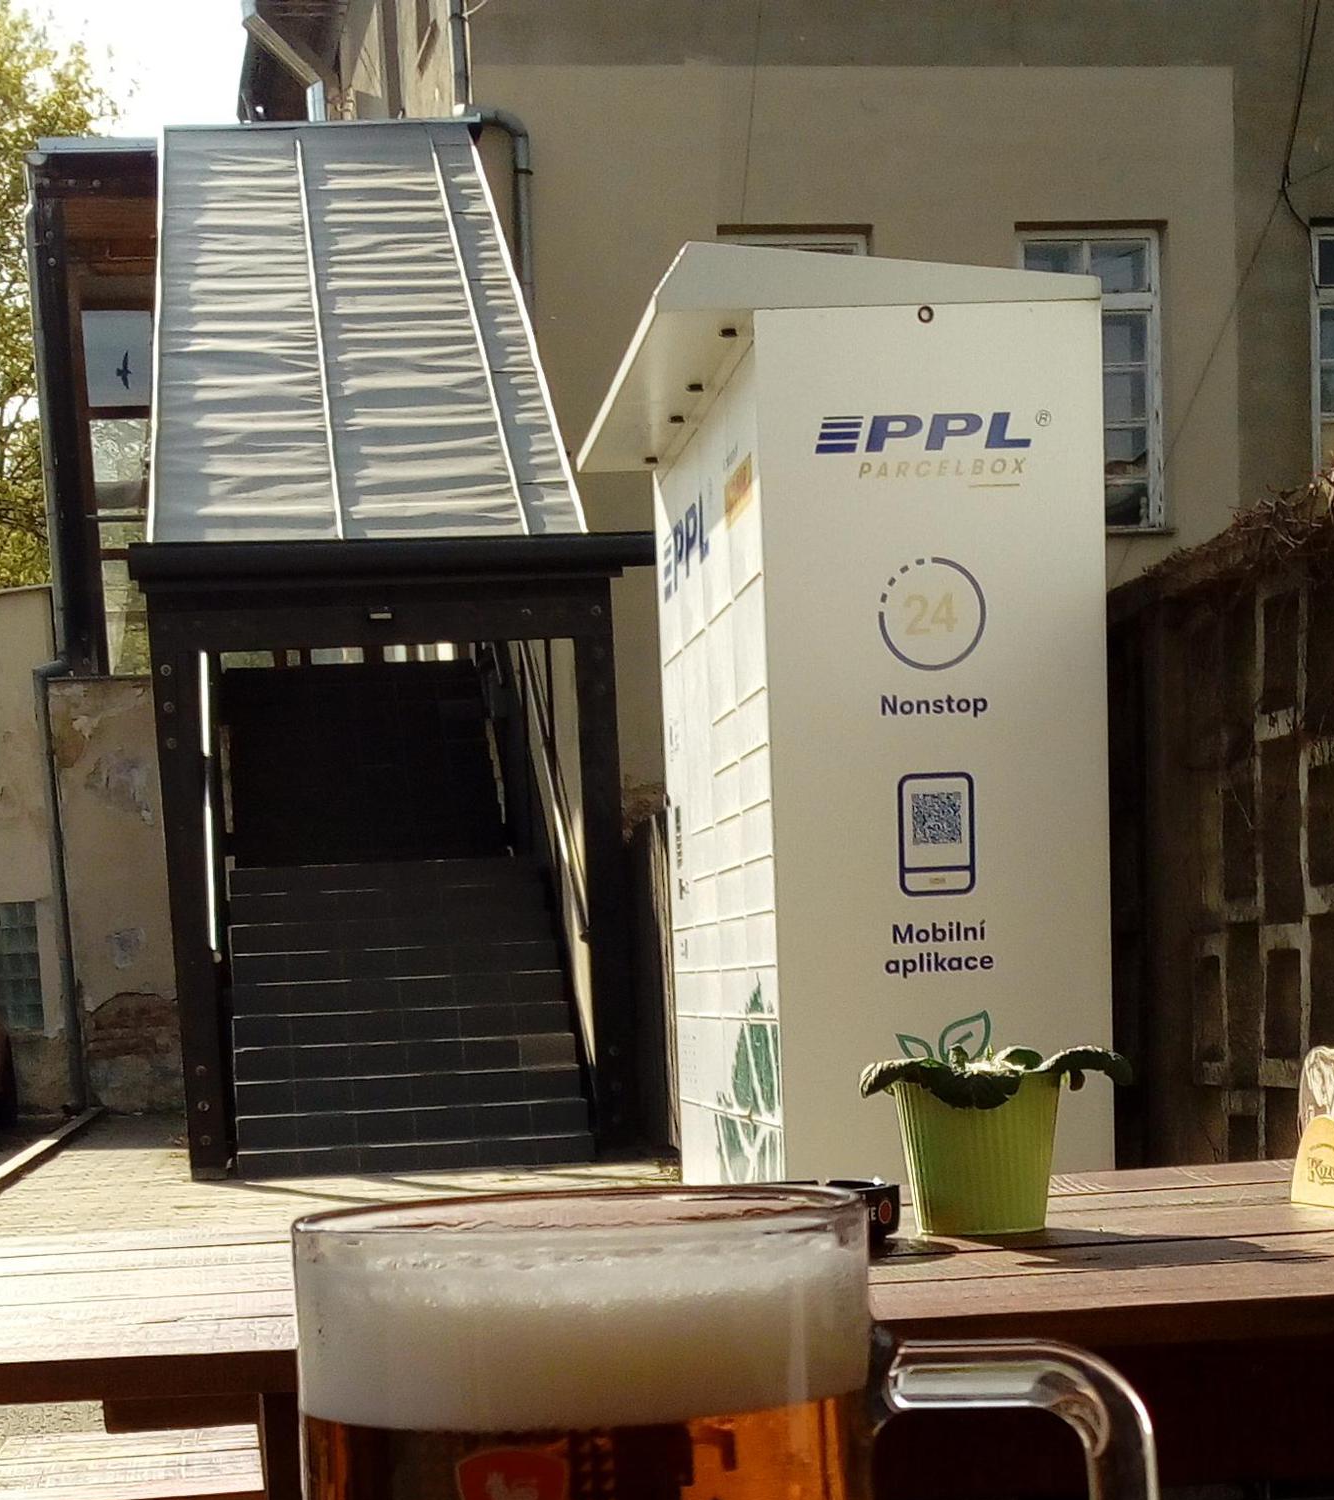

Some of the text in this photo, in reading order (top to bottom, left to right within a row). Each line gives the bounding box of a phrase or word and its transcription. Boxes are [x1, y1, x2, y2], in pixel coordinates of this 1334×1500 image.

[865, 412, 1032, 453] PPL
[858, 458, 1026, 479] PARCELBOX
[674, 489, 709, 592] PPL
[903, 592, 958, 635] 24
[881, 694, 988, 718] Nonstop
[892, 920, 986, 944] Mobilní
[885, 952, 994, 979] aplikace
